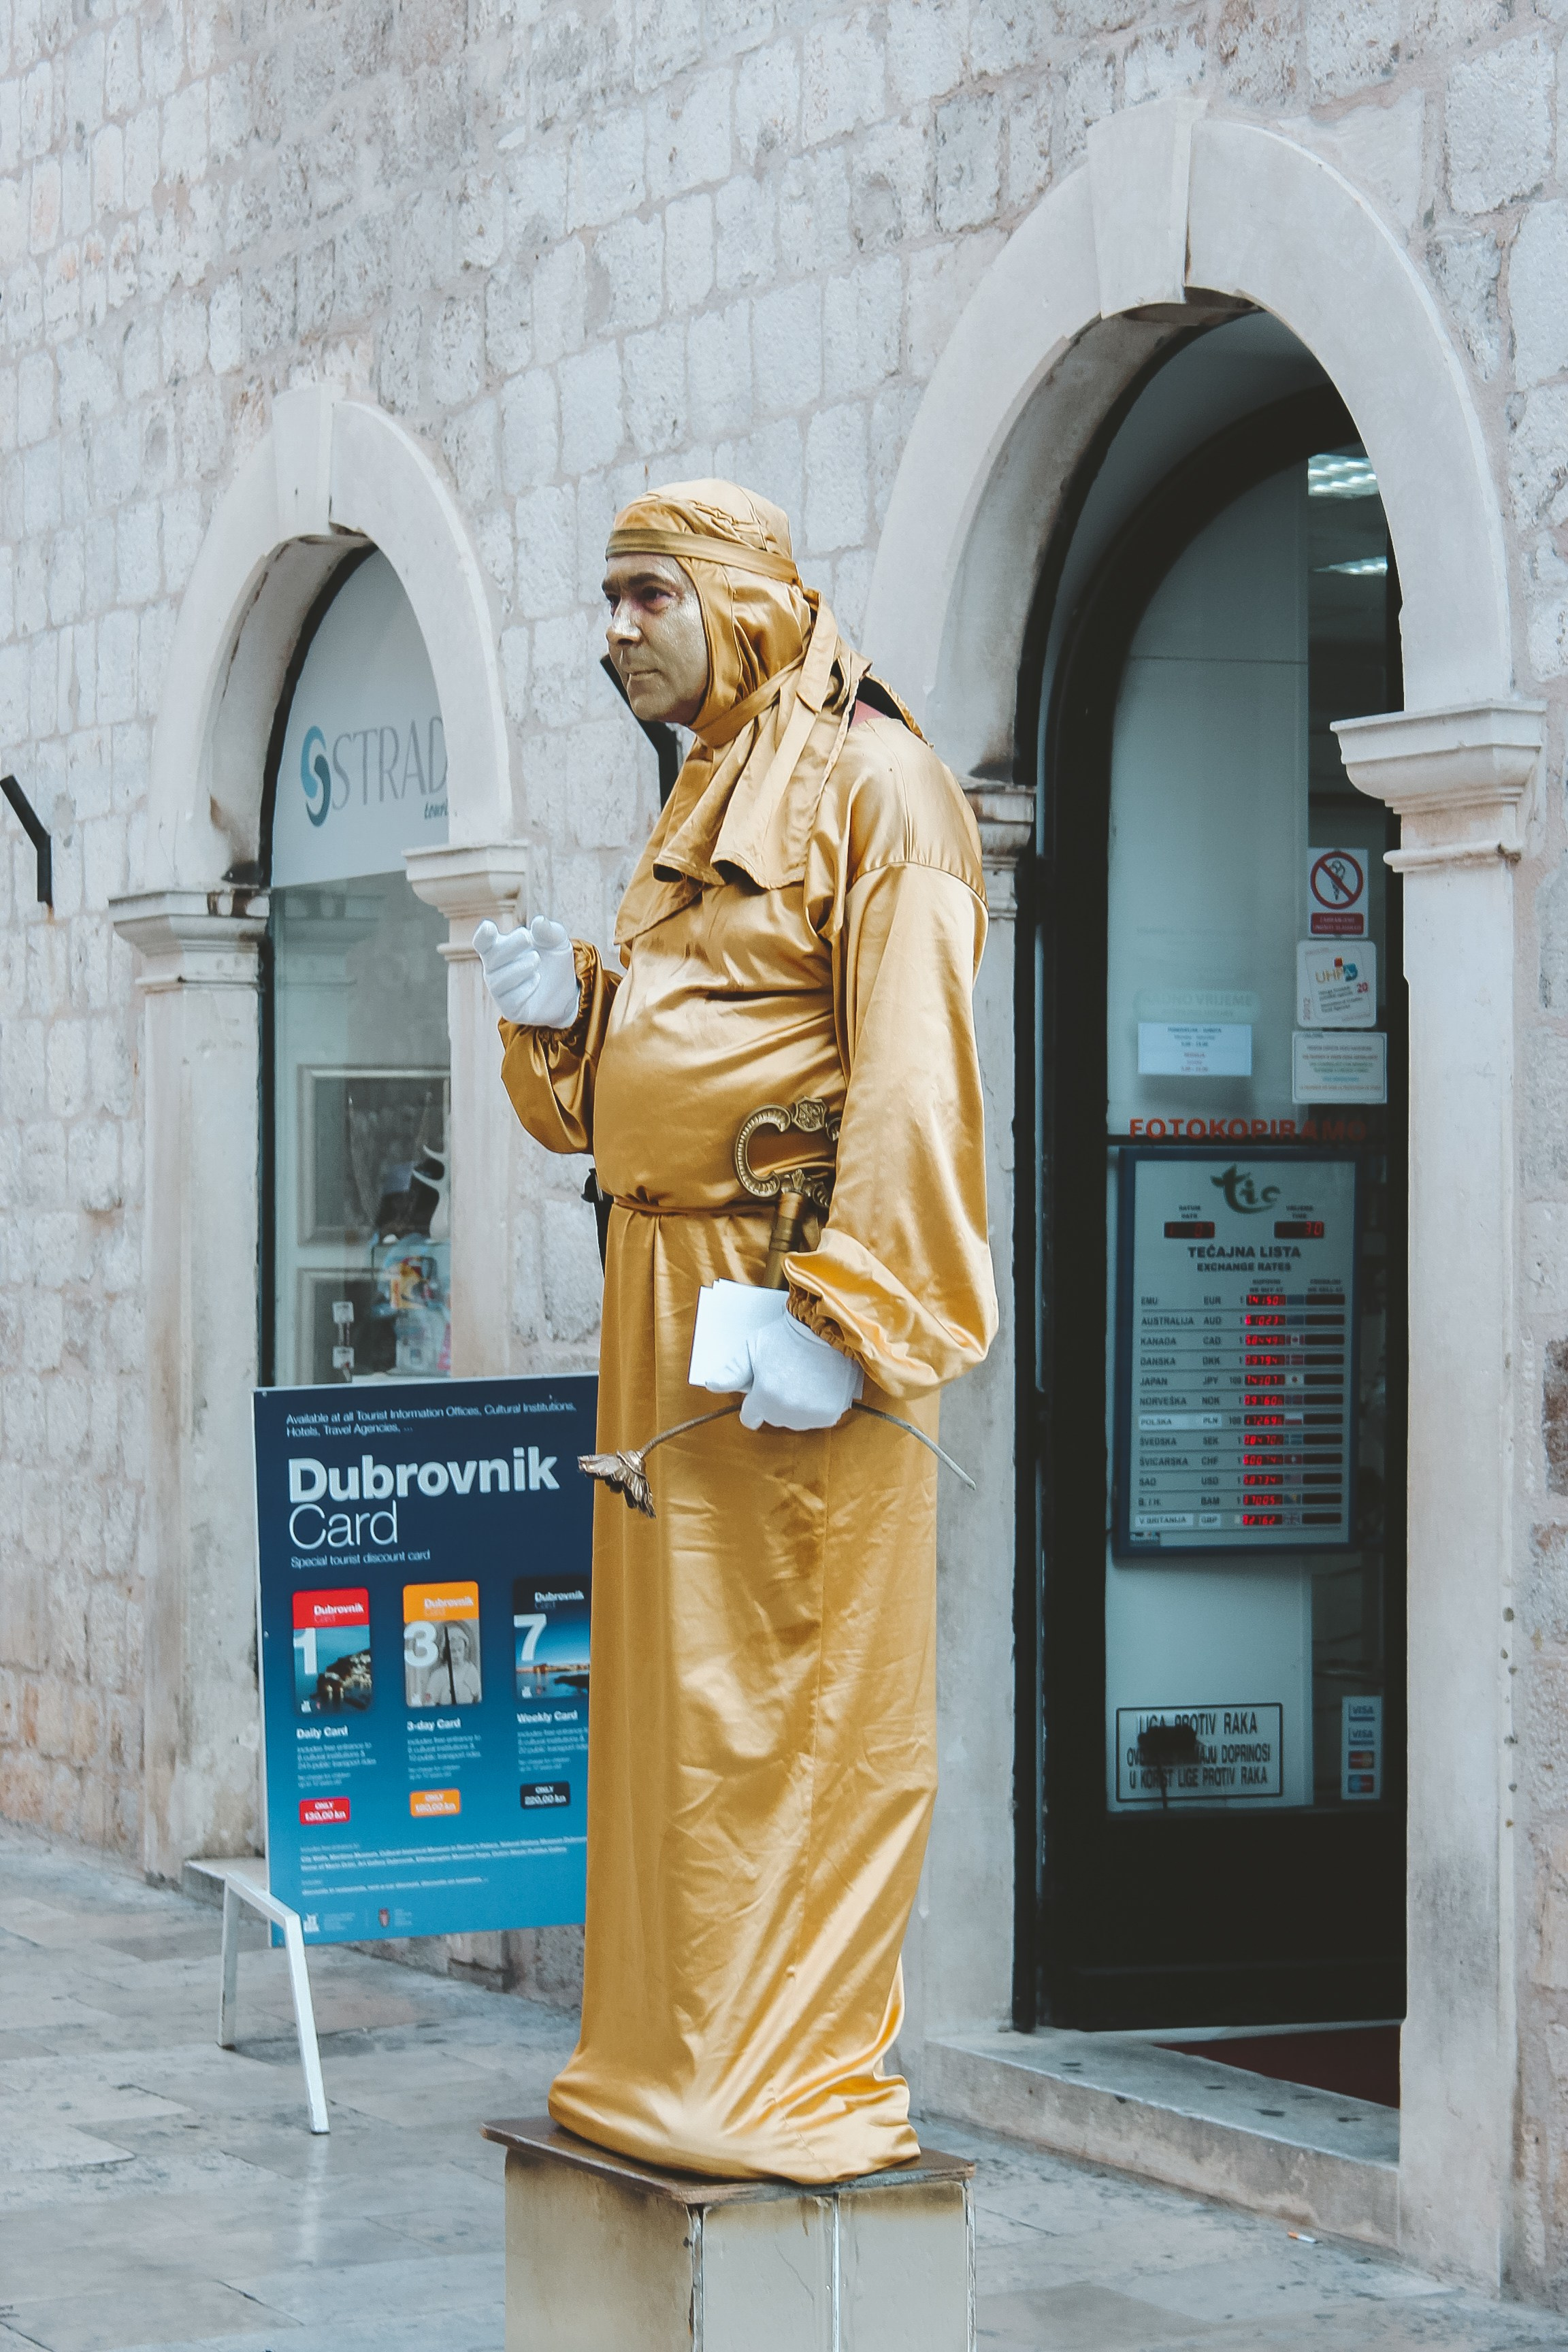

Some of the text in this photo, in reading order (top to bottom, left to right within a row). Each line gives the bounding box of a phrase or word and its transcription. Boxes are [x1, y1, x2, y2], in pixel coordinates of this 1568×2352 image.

[1129, 1117, 1367, 1141] FOTOKOPIRAMO
[1210, 1162, 1281, 1214] tic
[1260, 1245, 1301, 1258] LISTA
[1196, 1262, 1292, 1272] EXCHANGE RATES
[1141, 1296, 1158, 1305] EMU
[1203, 1296, 1221, 1305] EUR
[1141, 1316, 1194, 1325] AUSTRALIJA
[1204, 1316, 1222, 1325] AUD
[1140, 1337, 1177, 1345] KANADA
[1203, 1337, 1221, 1345] CAD
[1140, 1356, 1175, 1366] DANSKA
[1203, 1356, 1220, 1365] DKK
[1139, 1377, 1168, 1386] JAPAN
[1203, 1376, 1218, 1385] JPY
[1202, 1396, 1220, 1405] NOK
[286, 1414, 329, 1424] Available
[331, 1412, 340, 1422] at
[343, 1411, 354, 1422] all
[356, 1410, 387, 1421] Tourist
[390, 1407, 444, 1419] Information
[484, 1403, 521, 1415] Cultural
[286, 1426, 321, 1437] Hotels,
[323, 1424, 351, 1435] Travel
[1203, 1436, 1218, 1446] SEK
[1202, 1456, 1218, 1465] CHF
[289, 1446, 560, 1503] Dubrovnik
[1139, 1477, 1156, 1486] SAD
[1201, 1476, 1218, 1485] USD
[1200, 1497, 1220, 1506] BAM
[289, 1500, 398, 1549] Card
[291, 1549, 431, 1569] Special tourist discount card
[423, 1597, 474, 1608] Dubrovnik
[534, 1590, 585, 1603] Dubrovnik
[313, 1603, 364, 1616] Dubrovnik
[404, 1621, 439, 1667] 3
[514, 1614, 547, 1661] 7
[293, 1627, 317, 1675] 1
[517, 1710, 578, 1724] Weekly Card
[1224, 1712, 1257, 1735] RAKA
[406, 1718, 461, 1731] 3-day Card
[296, 1725, 348, 1740] Daily Card
[1221, 1744, 1271, 1763] DOPRINOSI
[1130, 1770, 1136, 1789] U
[1178, 1767, 1198, 1787] LIGE
[1202, 1767, 1235, 1786] PROTIV
[1241, 1766, 1267, 1785] RAKA
